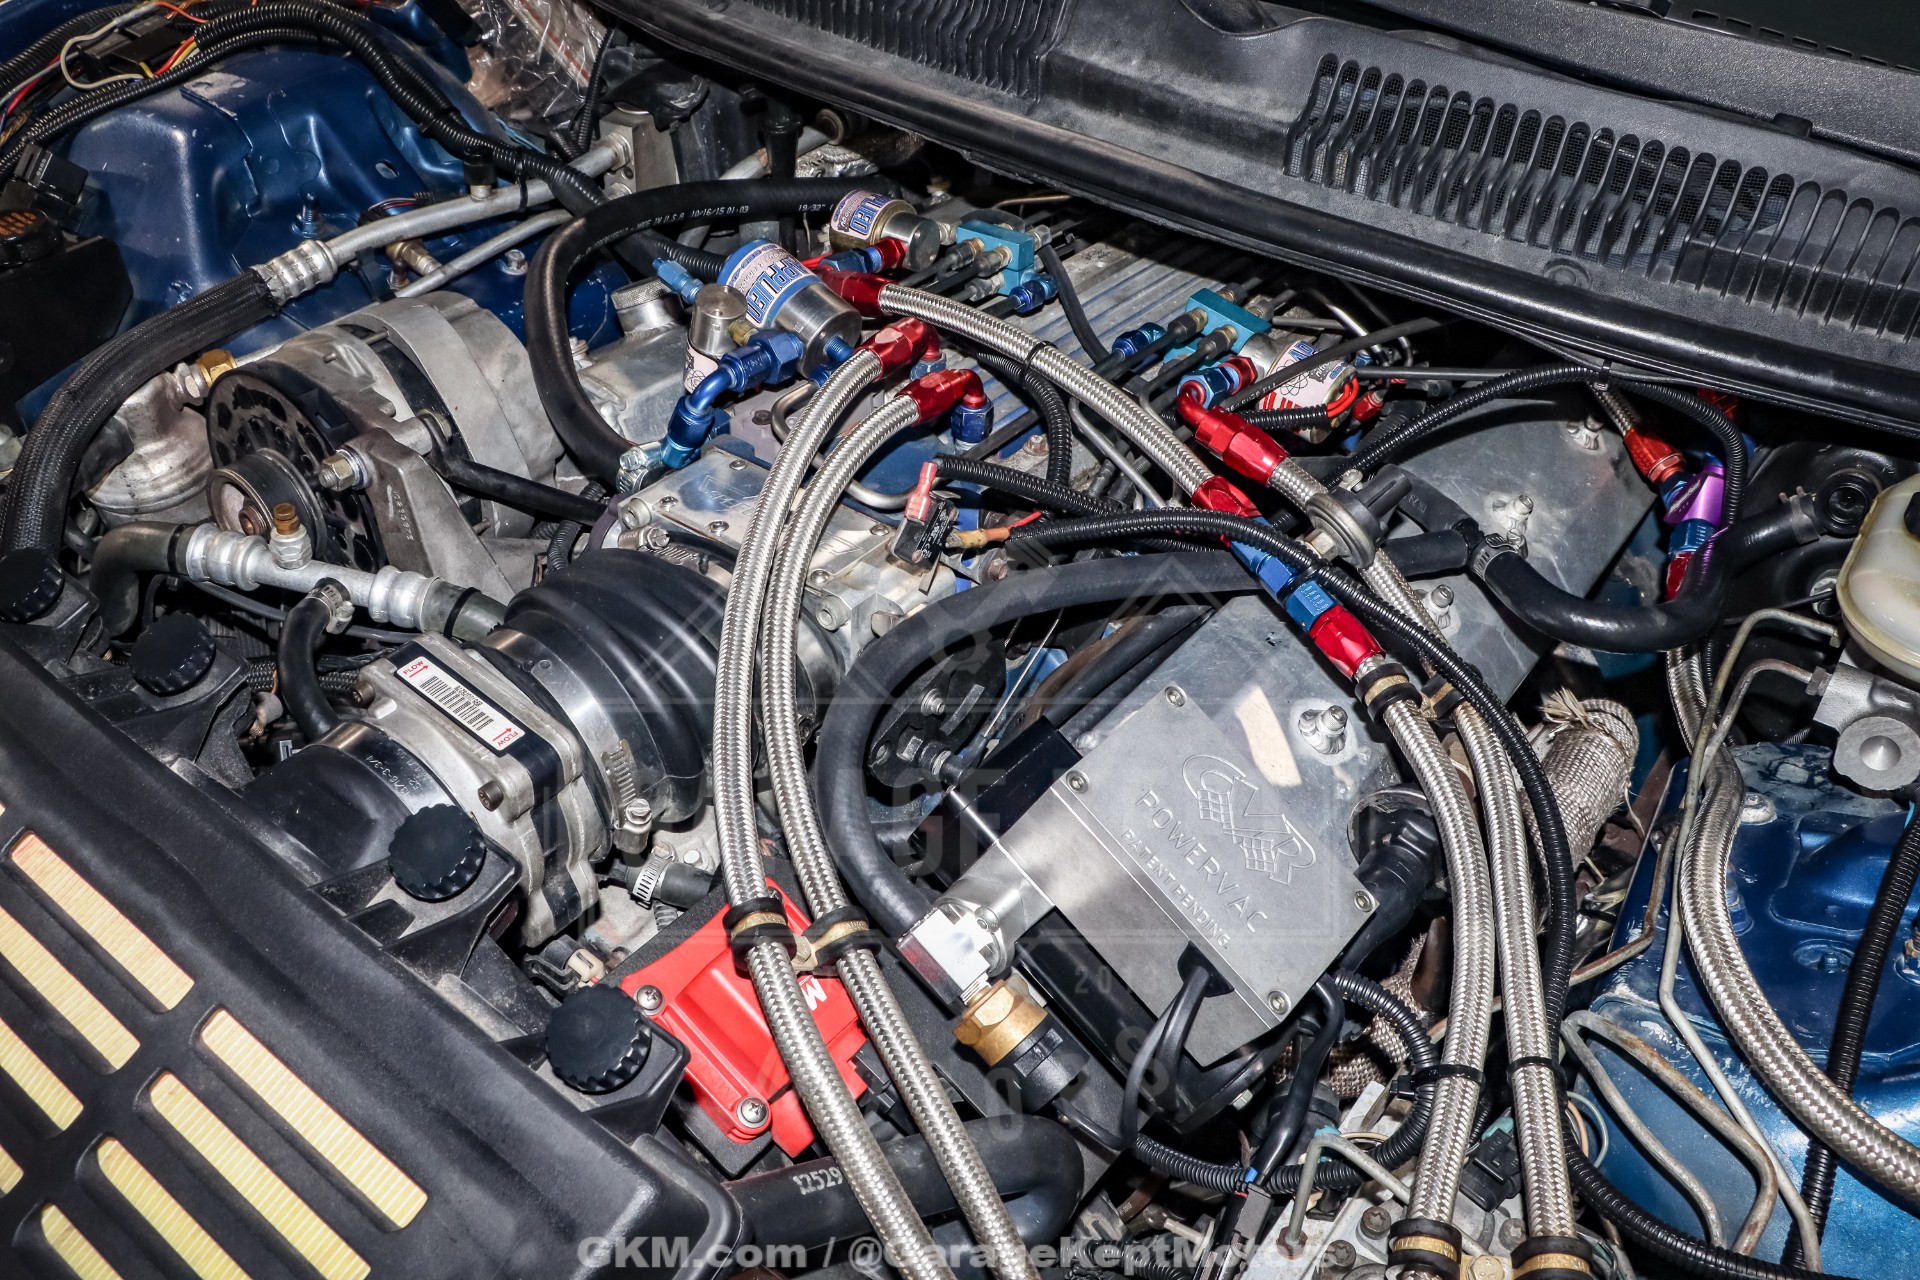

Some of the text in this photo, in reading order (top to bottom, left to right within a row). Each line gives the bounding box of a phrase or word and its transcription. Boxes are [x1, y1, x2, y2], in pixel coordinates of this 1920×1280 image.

[690, 205, 725, 218] 10/16/15
[849, 193, 893, 236] PLIED
[402, 660, 425, 676] FLOW
[497, 731, 519, 747] FLOW
[1120, 828, 1177, 886] PATENT
[1135, 789, 1268, 933] POWERVAC
